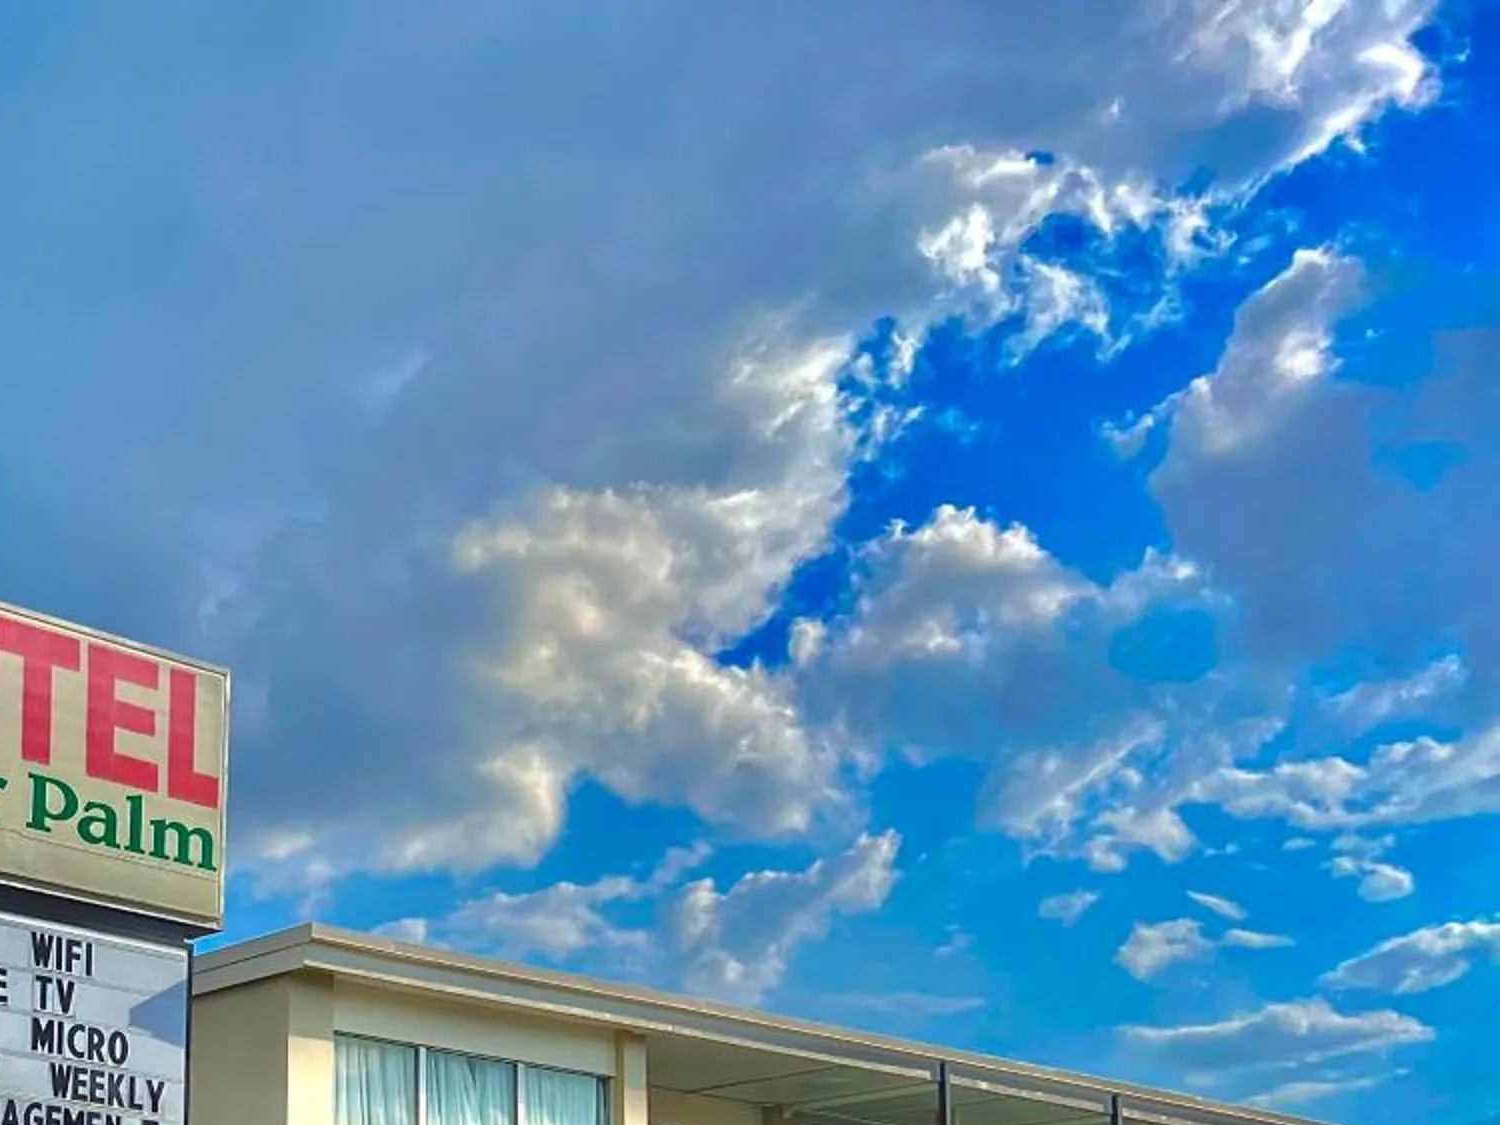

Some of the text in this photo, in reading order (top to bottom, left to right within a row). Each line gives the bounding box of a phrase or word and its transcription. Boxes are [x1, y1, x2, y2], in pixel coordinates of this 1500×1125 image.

[26, 772, 217, 872] Palm
[31, 931, 94, 977] WIFI
[35, 975, 75, 1014] TV
[31, 1018, 129, 1065] MICRO
[50, 1062, 164, 1113] WEEKLY
